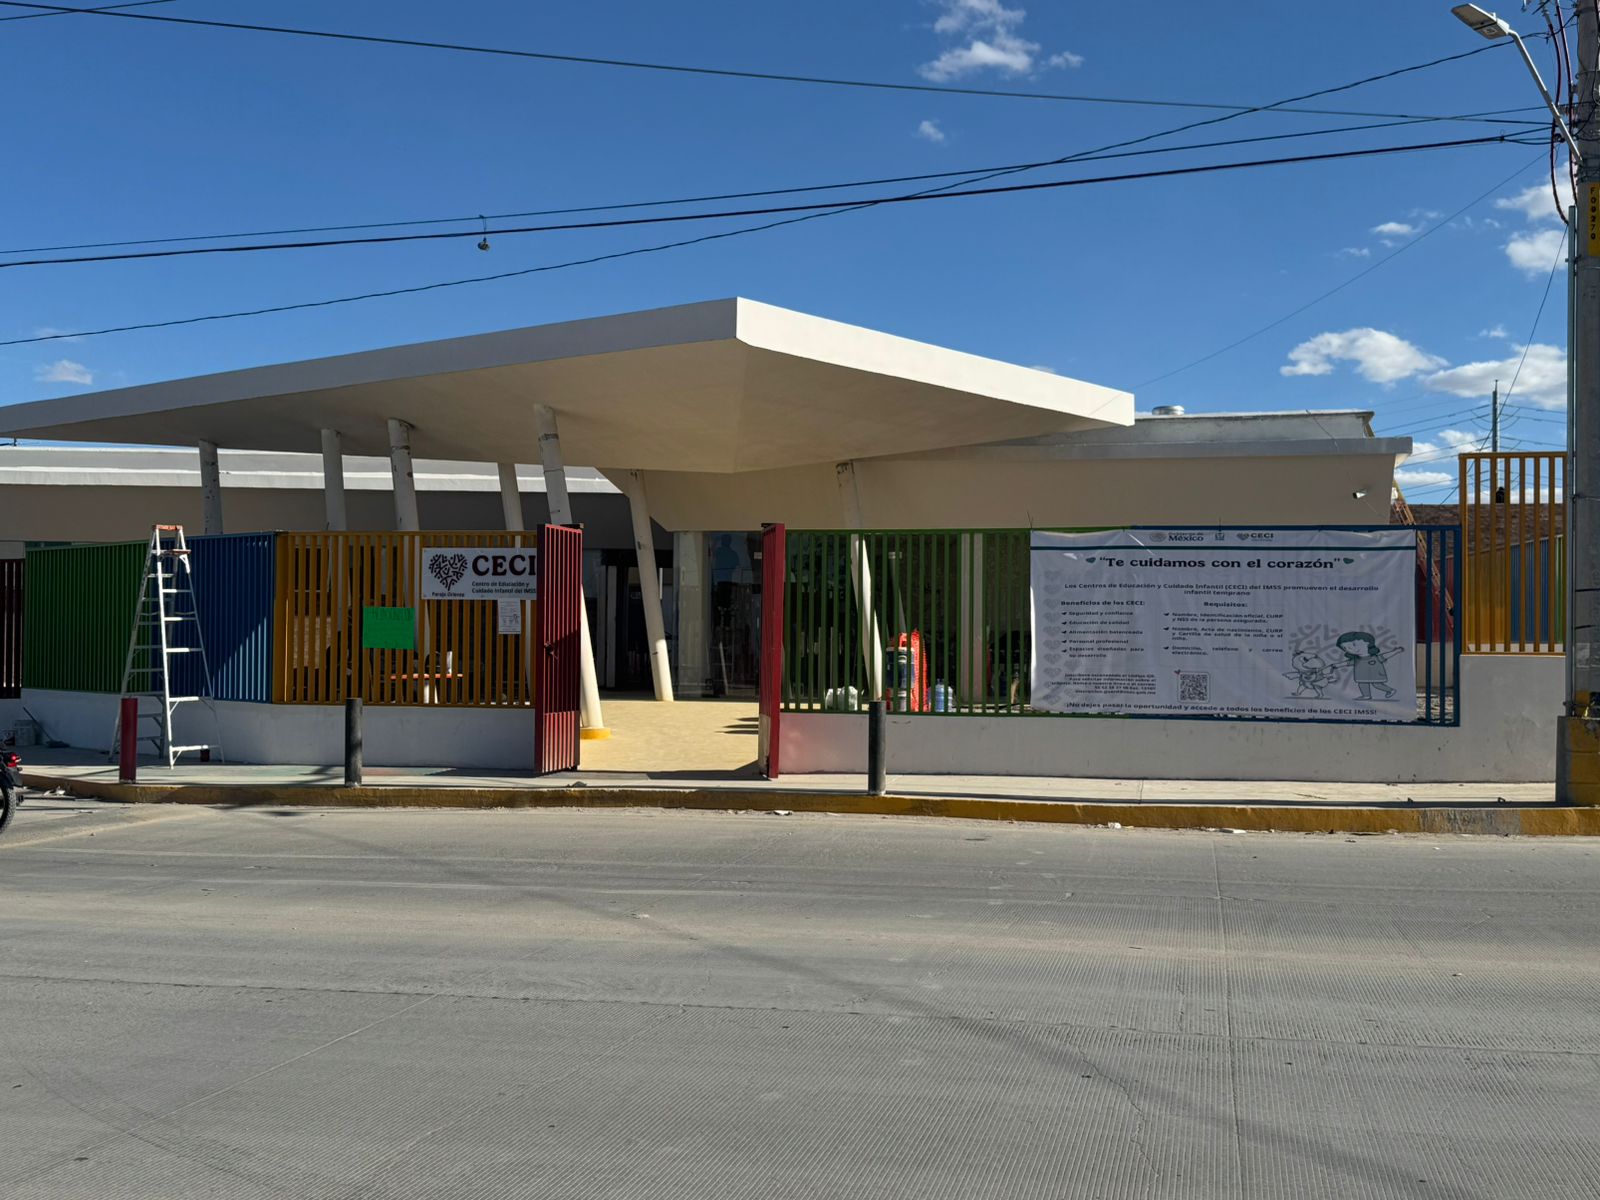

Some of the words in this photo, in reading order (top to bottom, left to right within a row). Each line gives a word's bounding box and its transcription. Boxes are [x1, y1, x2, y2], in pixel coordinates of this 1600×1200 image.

[472, 554, 536, 576] CECI
[1130, 558, 1205, 568] cuidamos
[1211, 560, 1241, 568] con
[1247, 558, 1261, 568] el
